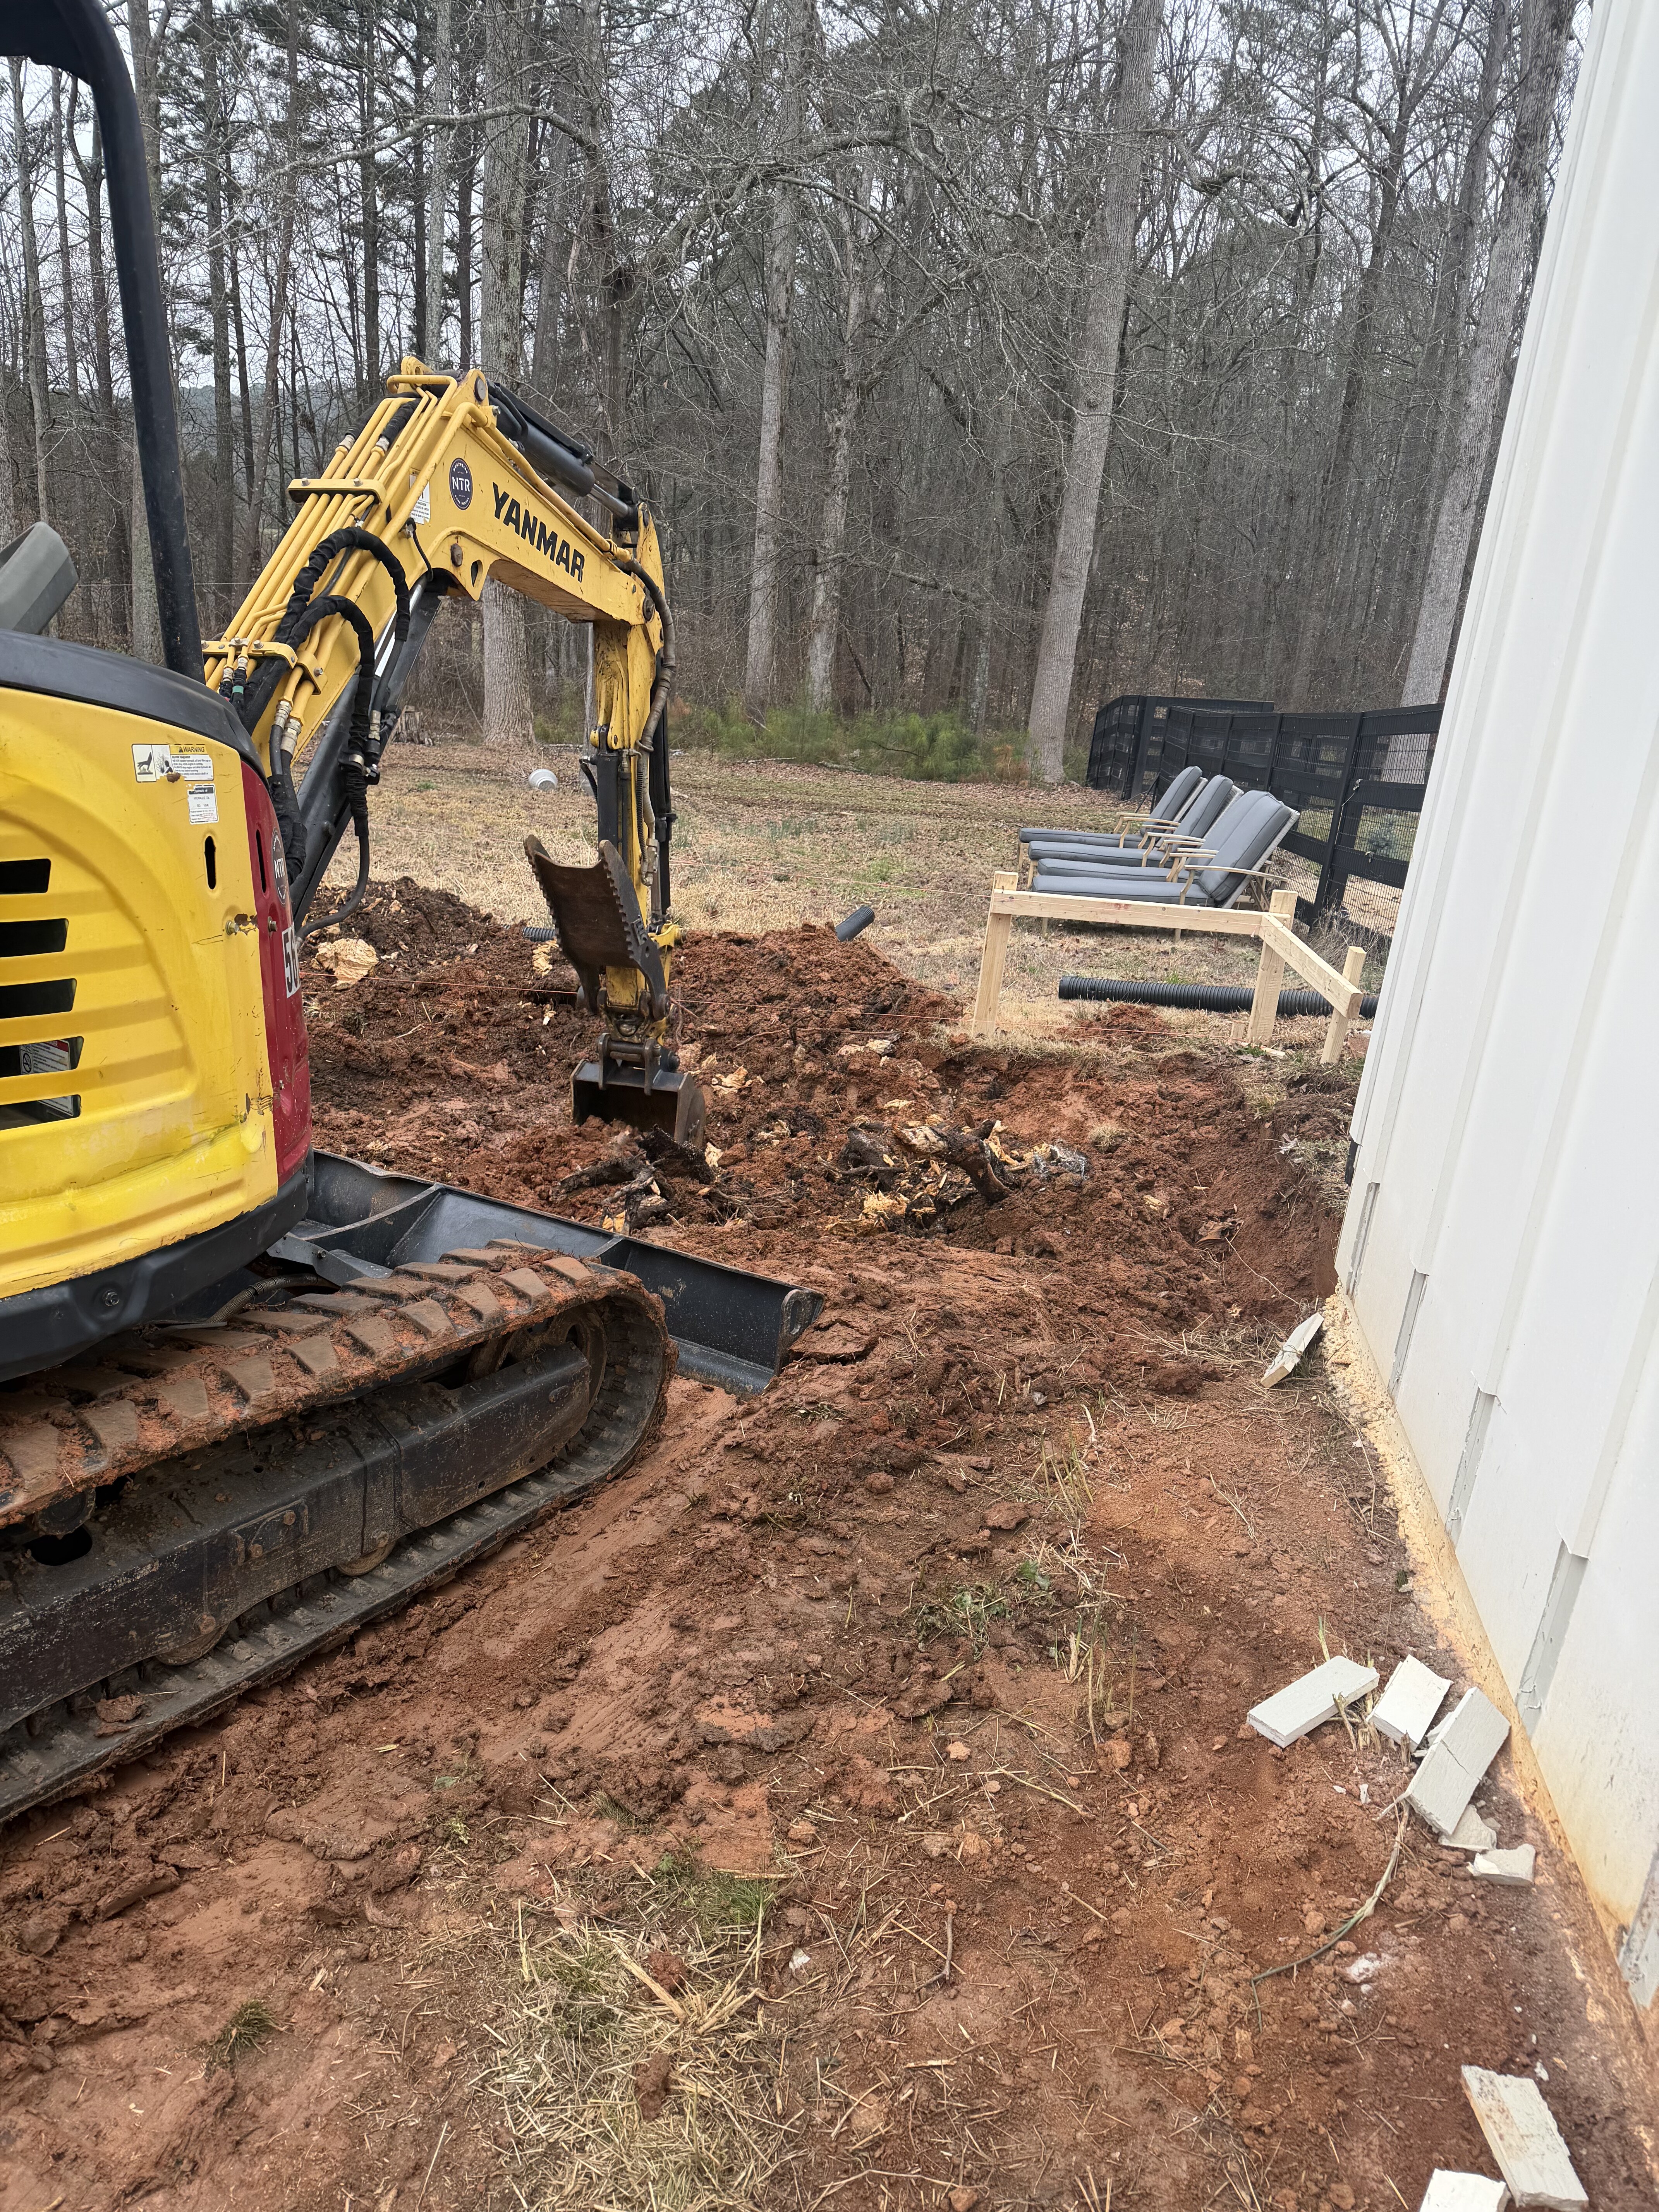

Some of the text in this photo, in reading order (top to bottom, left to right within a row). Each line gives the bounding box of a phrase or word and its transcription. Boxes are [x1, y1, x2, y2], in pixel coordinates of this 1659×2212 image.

[452, 476, 470, 492] NTR
[493, 481, 585, 583] YANMAR
[274, 858, 285, 879] NTR
